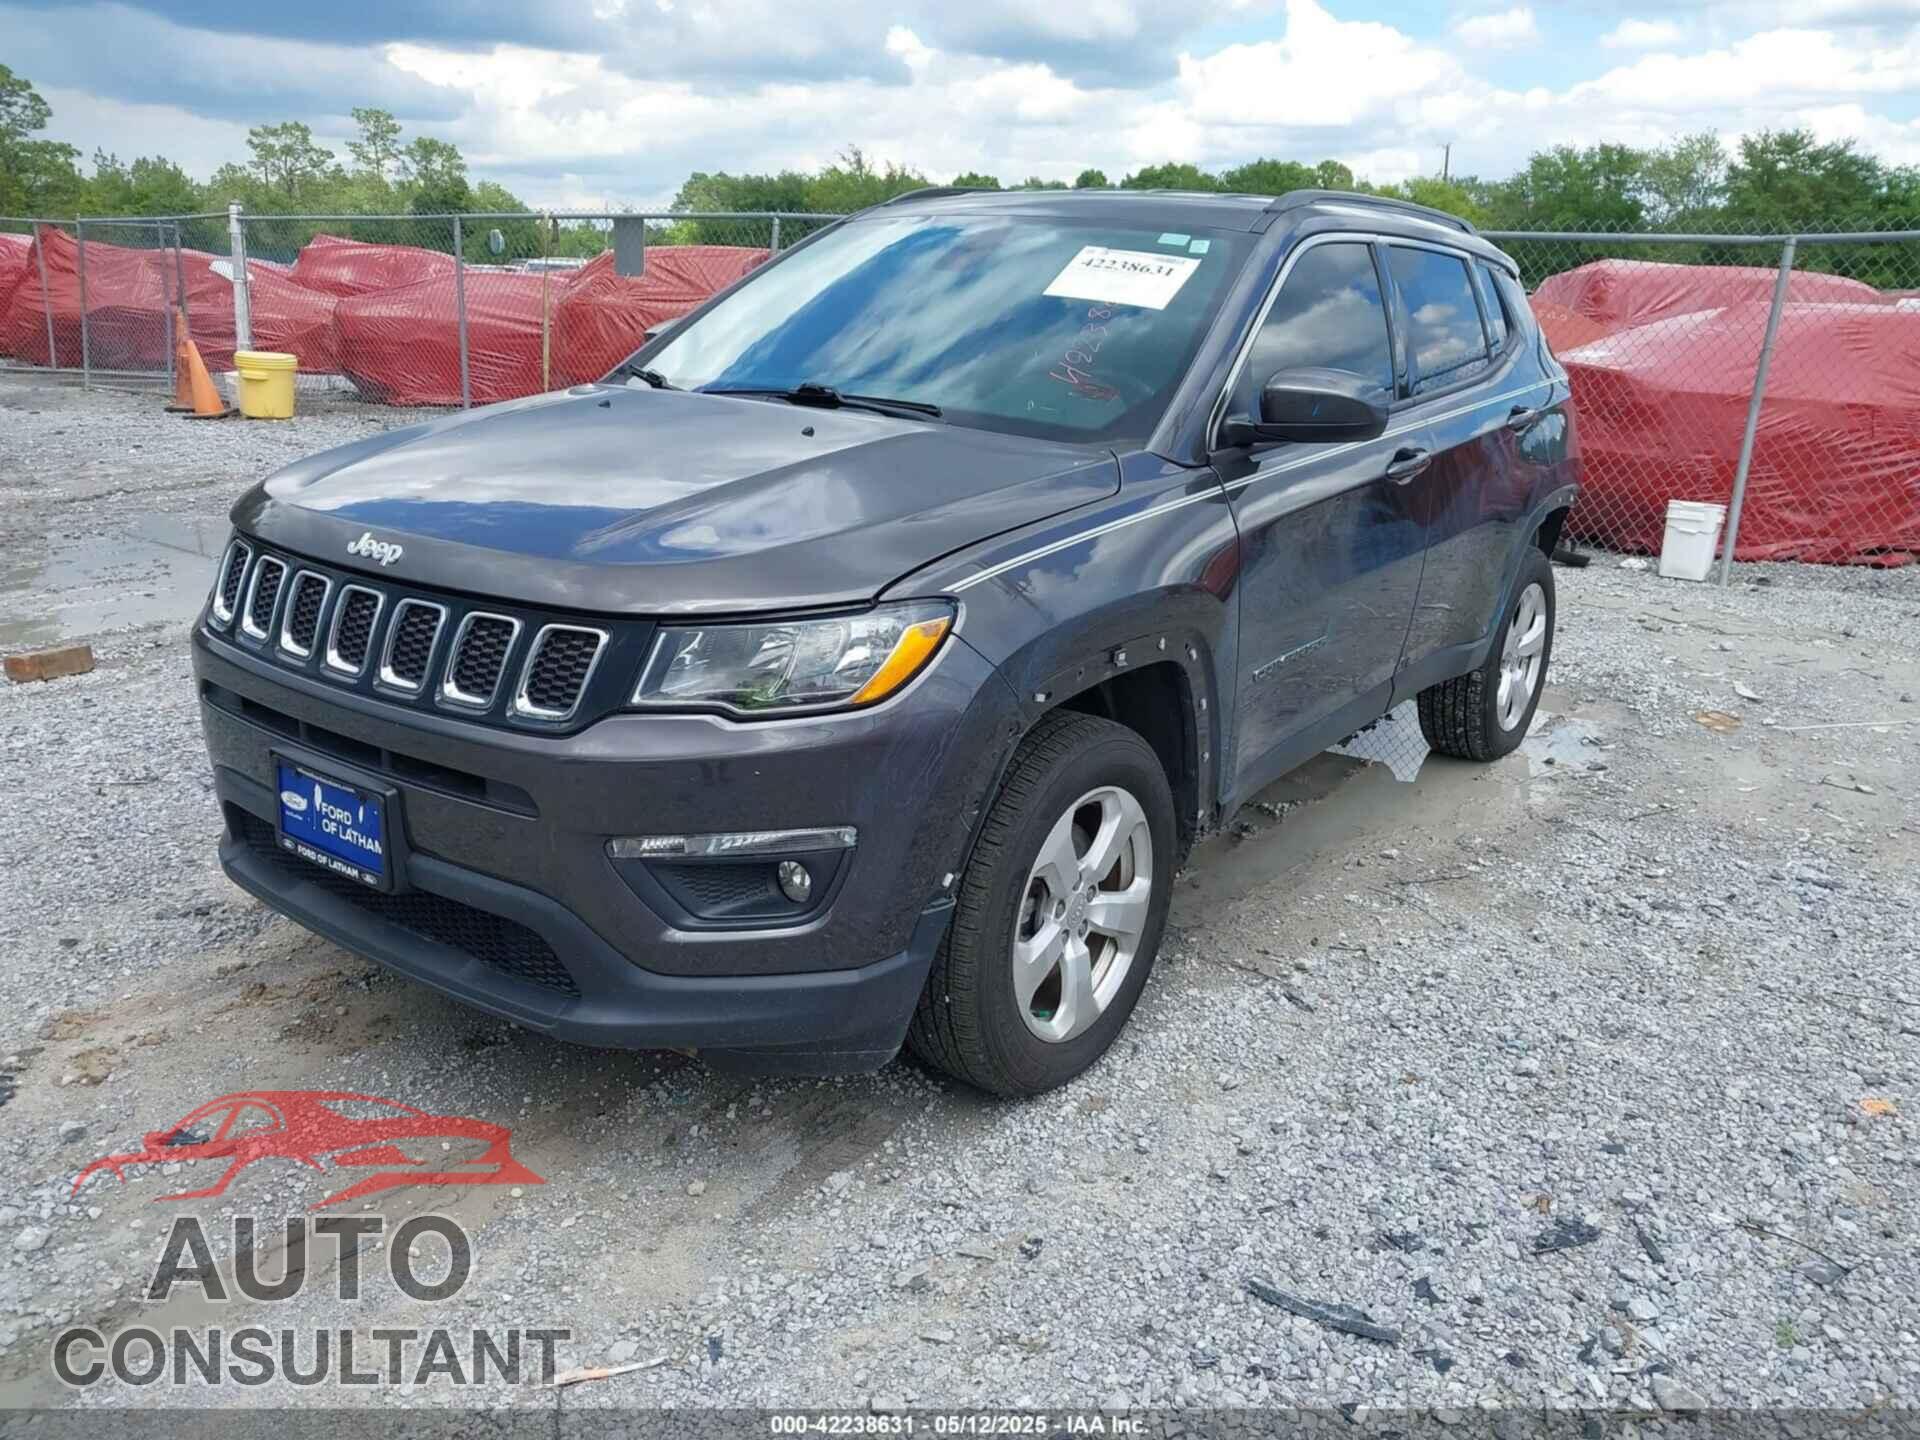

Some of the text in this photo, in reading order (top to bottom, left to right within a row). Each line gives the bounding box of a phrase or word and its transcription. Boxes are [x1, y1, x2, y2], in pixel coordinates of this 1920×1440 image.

[1081, 256, 1175, 278] 42238631
[347, 532, 403, 567] Jeep
[321, 802, 352, 826] FORD
[322, 818, 337, 835] OF
[297, 844, 317, 861] FORD
[317, 853, 328, 865] OF
[328, 857, 359, 880] LATHAM
